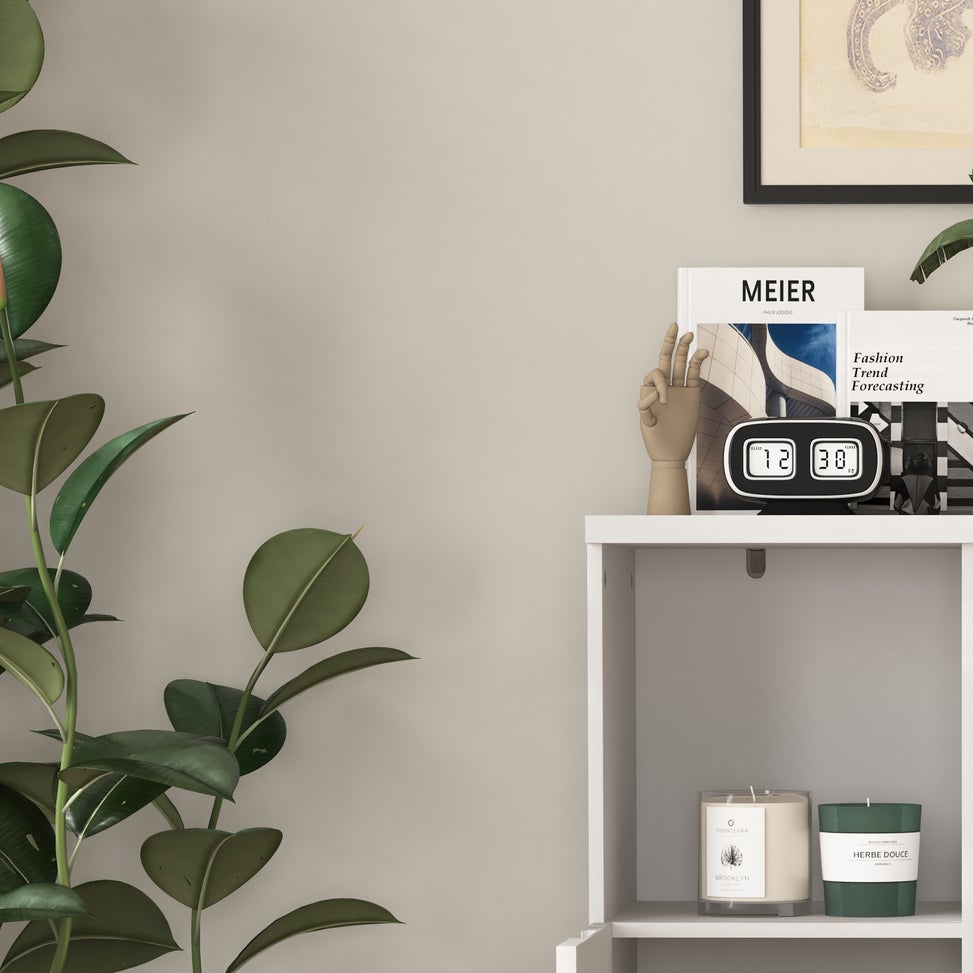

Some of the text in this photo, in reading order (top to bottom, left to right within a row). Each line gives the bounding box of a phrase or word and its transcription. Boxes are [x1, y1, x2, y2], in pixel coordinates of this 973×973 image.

[742, 279, 815, 302] MEIER
[853, 352, 903, 363] Fashion
[852, 367, 888, 378] Trend
[851, 380, 925, 394] Forecasting
[764, 449, 789, 469] 12
[819, 449, 845, 469] 30
[883, 850, 909, 858] DOUCE
